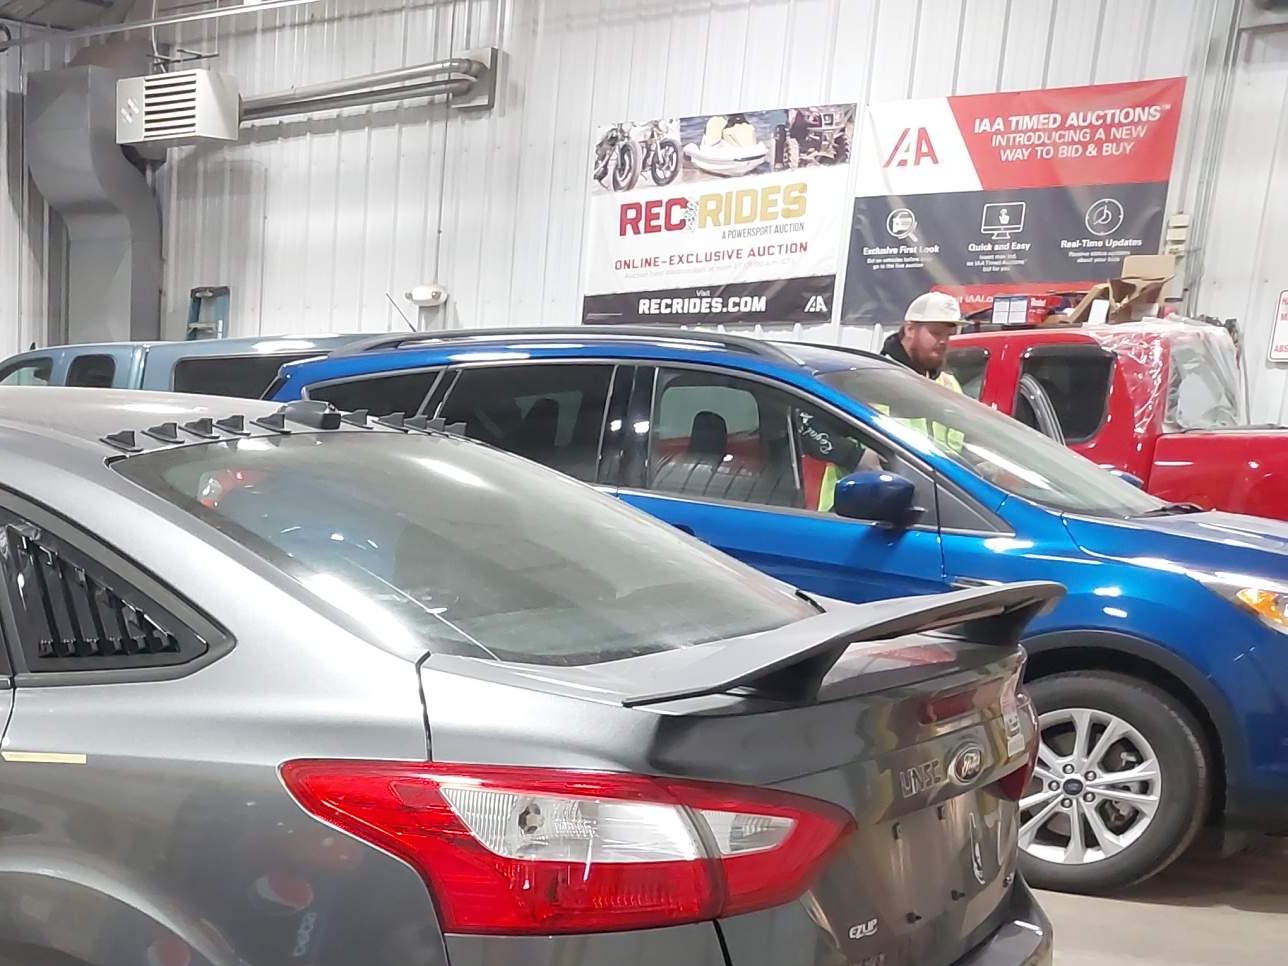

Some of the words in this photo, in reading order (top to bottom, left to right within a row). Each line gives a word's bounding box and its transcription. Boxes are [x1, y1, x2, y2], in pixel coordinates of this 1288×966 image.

[974, 117, 1005, 134] IAA
[1008, 113, 1062, 131] TIMED
[991, 129, 1091, 147] INTRODUCING
[1094, 129, 1106, 141] A
[1110, 125, 1148, 140] NEW
[999, 147, 1032, 162] WAY
[1035, 145, 1054, 160] TO
[1058, 144, 1083, 159] BID
[1085, 143, 1098, 156] &
[1101, 141, 1135, 156] BUY
[619, 196, 690, 237] REC
[697, 182, 808, 229] RIDES
[721, 231, 727, 240] A
[727, 225, 772, 240] POWERSPORT
[773, 222, 805, 235] AUCTION
[899, 245, 918, 254] First
[968, 242, 993, 252] Quick
[994, 242, 1010, 251] and
[1011, 241, 1031, 251] Easy
[1105, 238, 1143, 248] Updates
[615, 248, 744, 270] ONLINE-EXCLUSIVE
[747, 241, 809, 258] AUCTION
[638, 296, 767, 314] RECRIDES.COM
